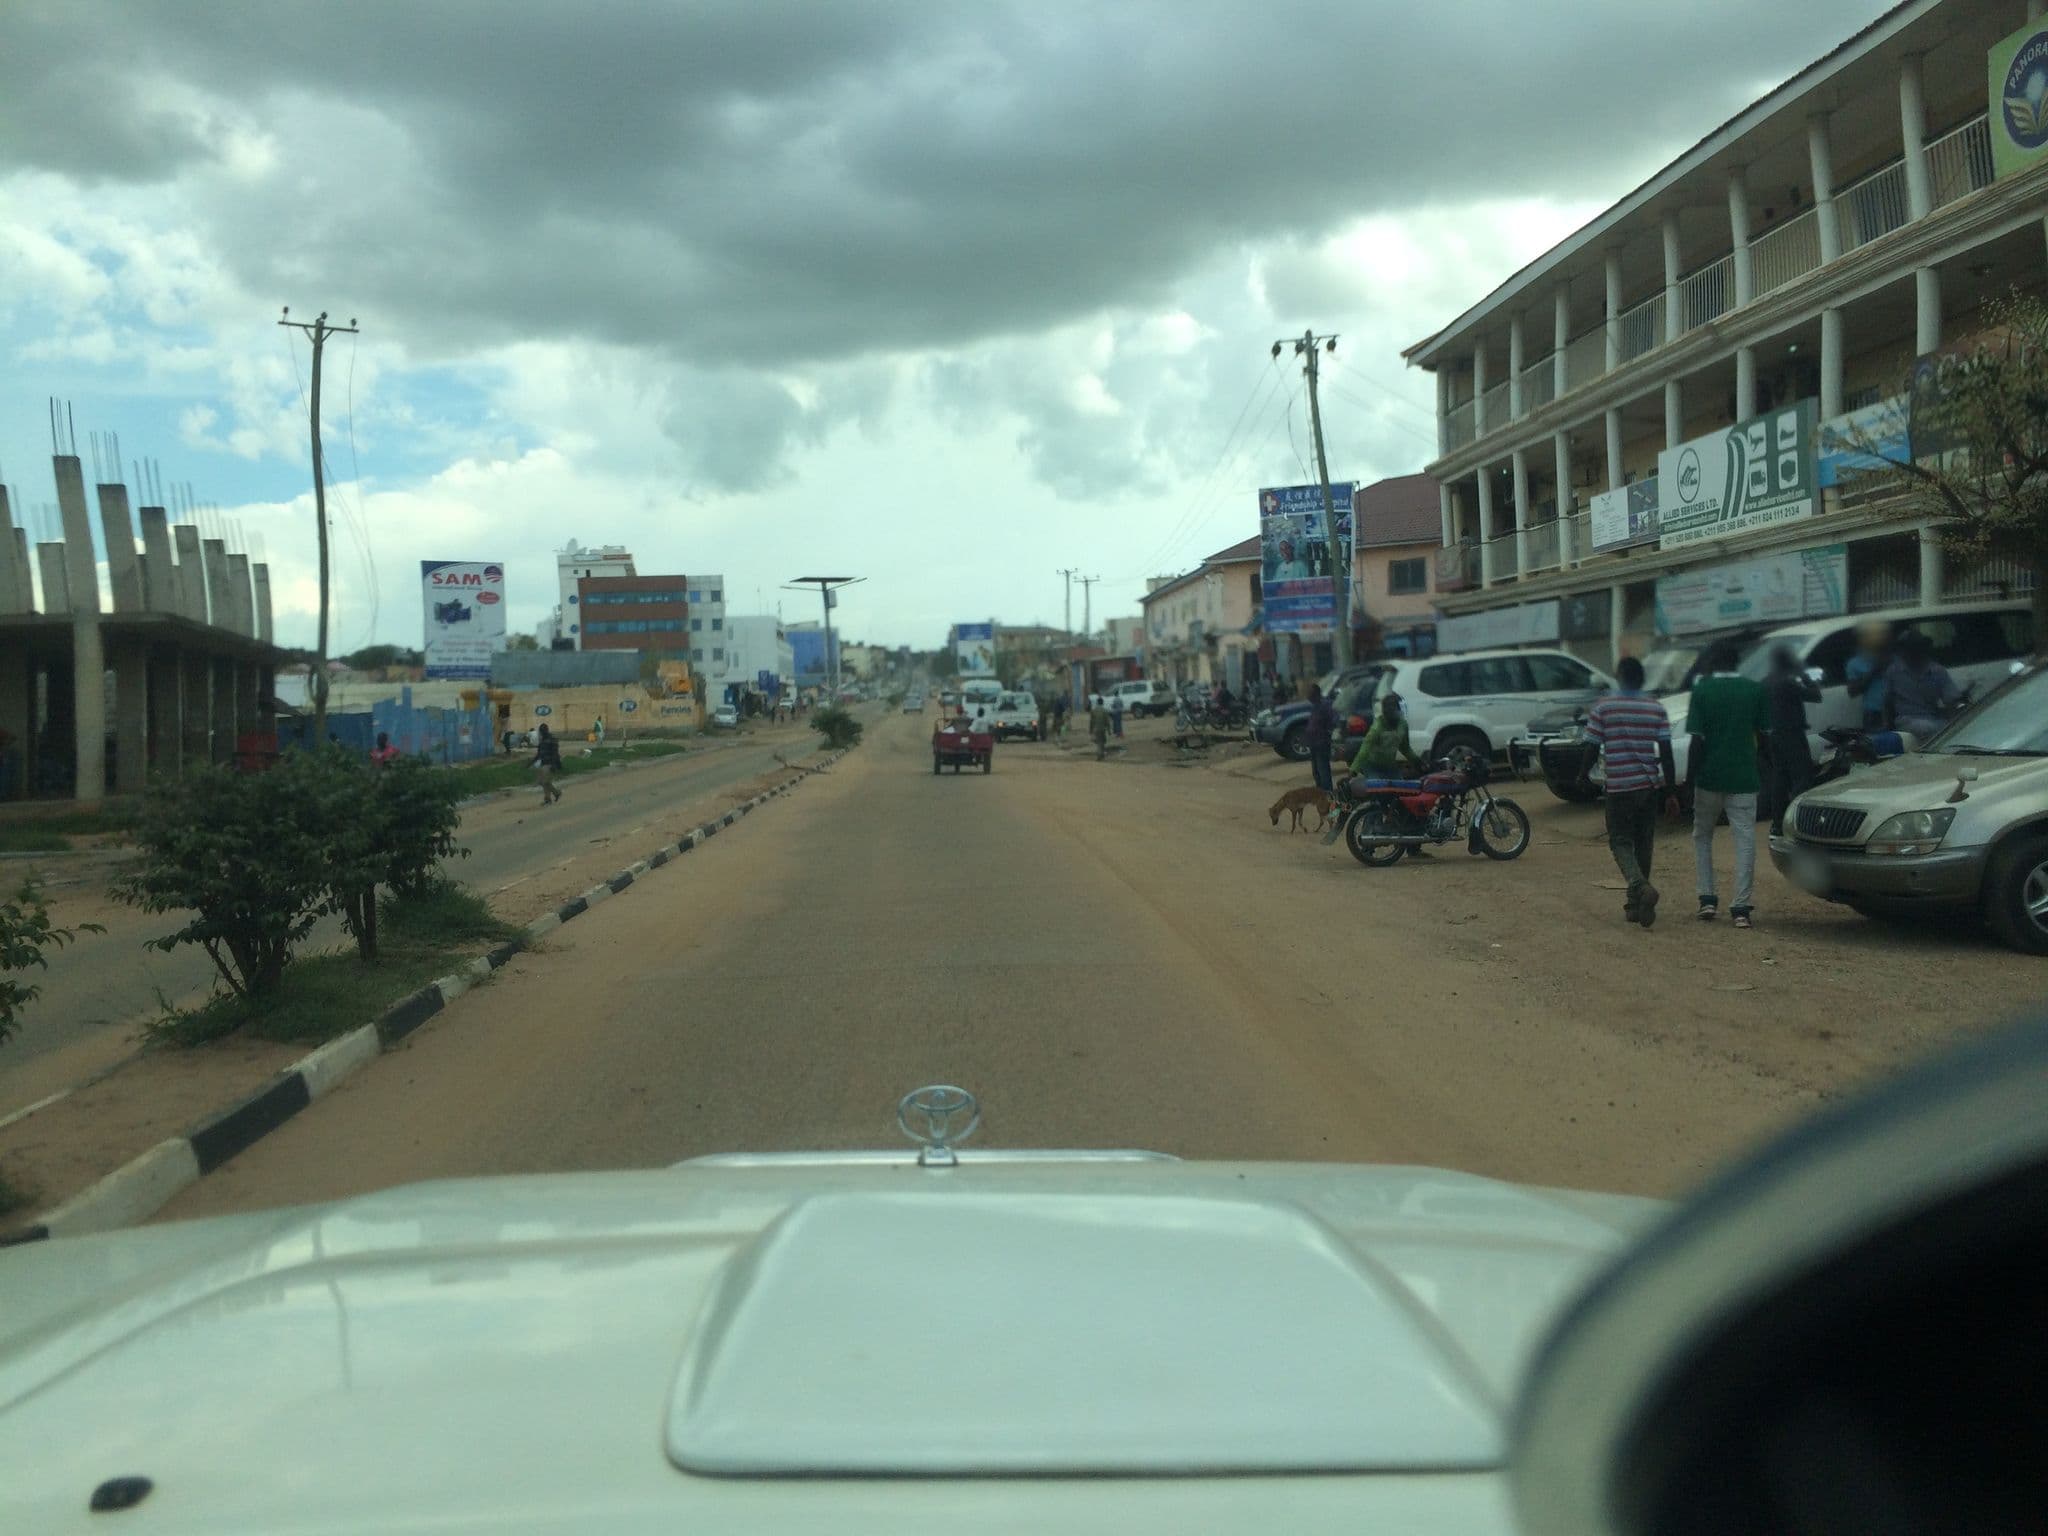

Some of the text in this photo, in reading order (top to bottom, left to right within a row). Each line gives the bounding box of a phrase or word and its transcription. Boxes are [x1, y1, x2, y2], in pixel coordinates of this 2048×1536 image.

[1280, 499, 1317, 511] Friendship
[1663, 498, 1719, 521] ALLIED SERVICES LTD.
[1749, 513, 1761, 525] +211
[1773, 508, 1783, 520] 111
[432, 572, 482, 586] SAM
